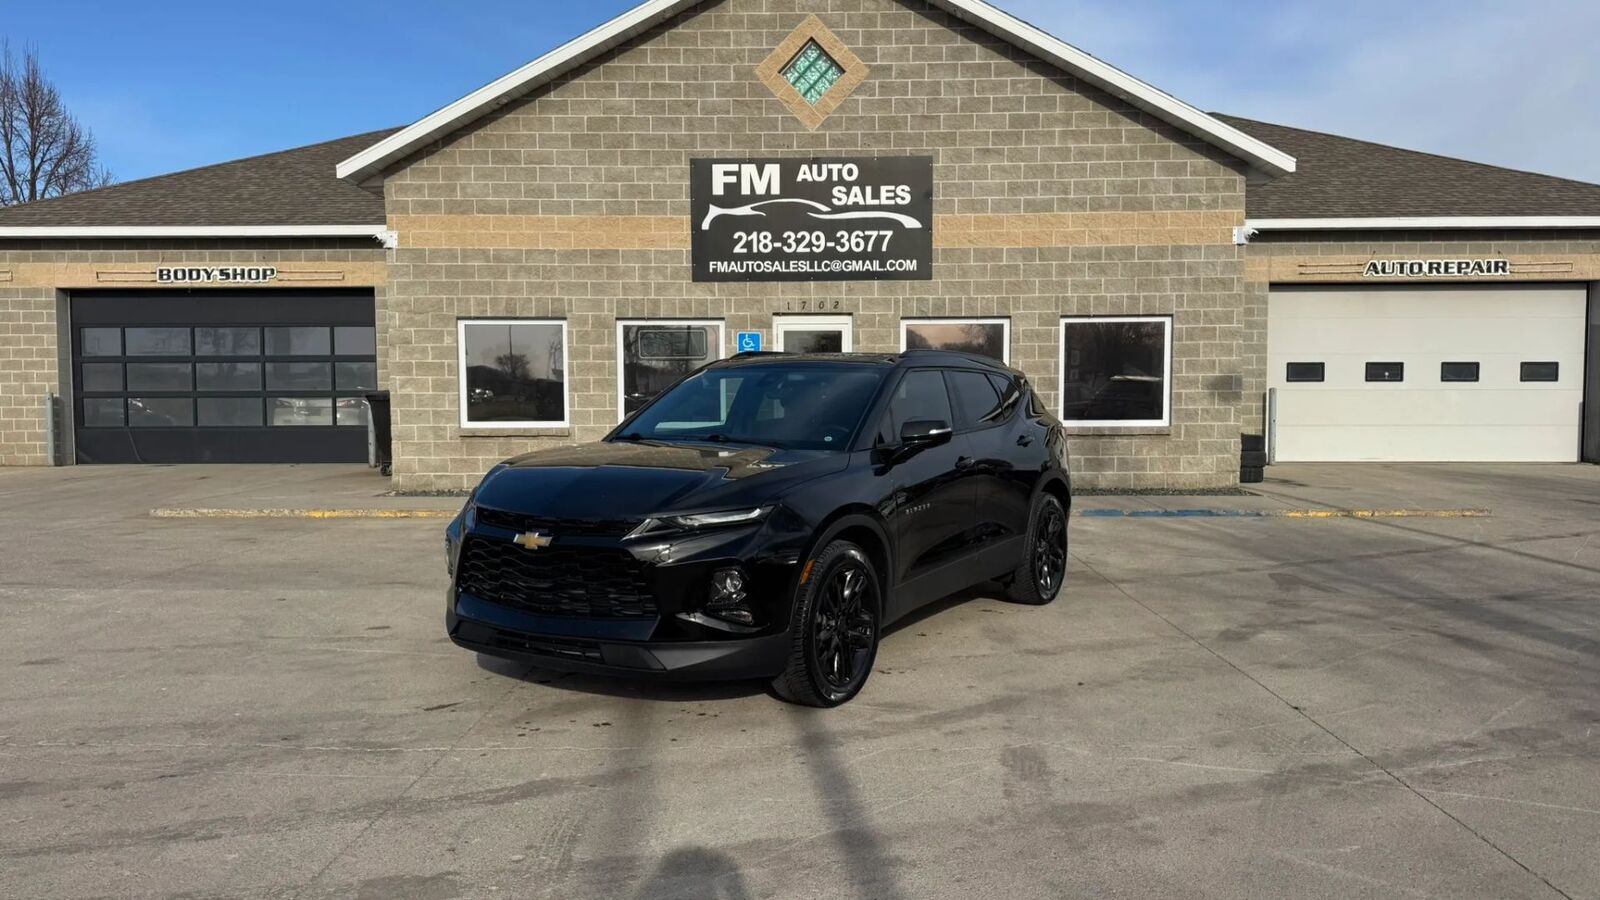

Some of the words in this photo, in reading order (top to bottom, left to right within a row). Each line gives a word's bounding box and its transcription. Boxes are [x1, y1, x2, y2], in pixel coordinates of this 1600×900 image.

[712, 163, 781, 196] FM
[796, 163, 859, 182] AUTO
[831, 185, 912, 206] SALES
[732, 230, 893, 253] 218-329-3677
[157, 267, 215, 282] BODY
[218, 267, 276, 282] SHOP
[709, 259, 918, 273] FMAUTOSALESLLC@GMAIL.COM
[1364, 260, 1424, 276] AUTO
[1426, 259, 1509, 275] REPAIR
[786, 300, 840, 311] 1702
